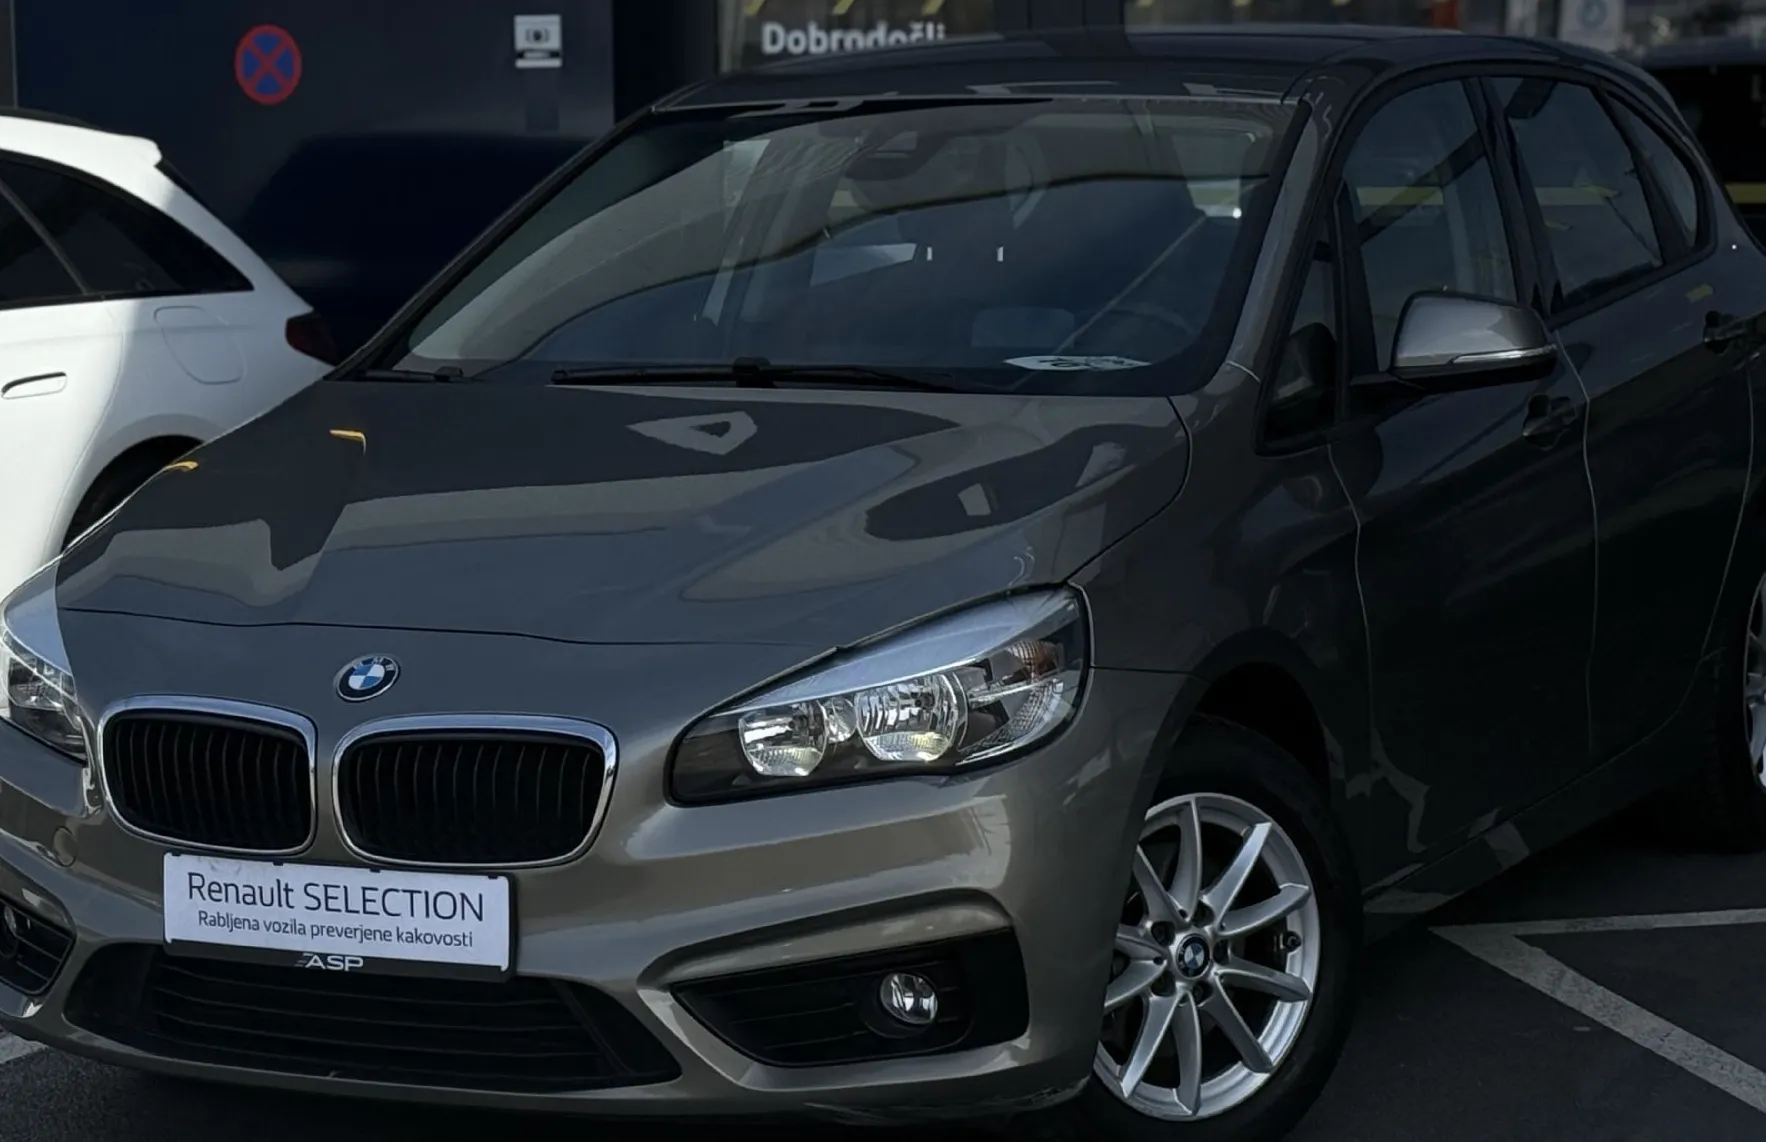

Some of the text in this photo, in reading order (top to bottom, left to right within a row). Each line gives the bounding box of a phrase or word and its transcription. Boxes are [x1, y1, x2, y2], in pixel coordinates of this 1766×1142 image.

[187, 872, 483, 921] Renault SELECTION
[198, 910, 473, 947] Rabljena vozila preverjene kakovosti
[304, 953, 364, 971] ASP
